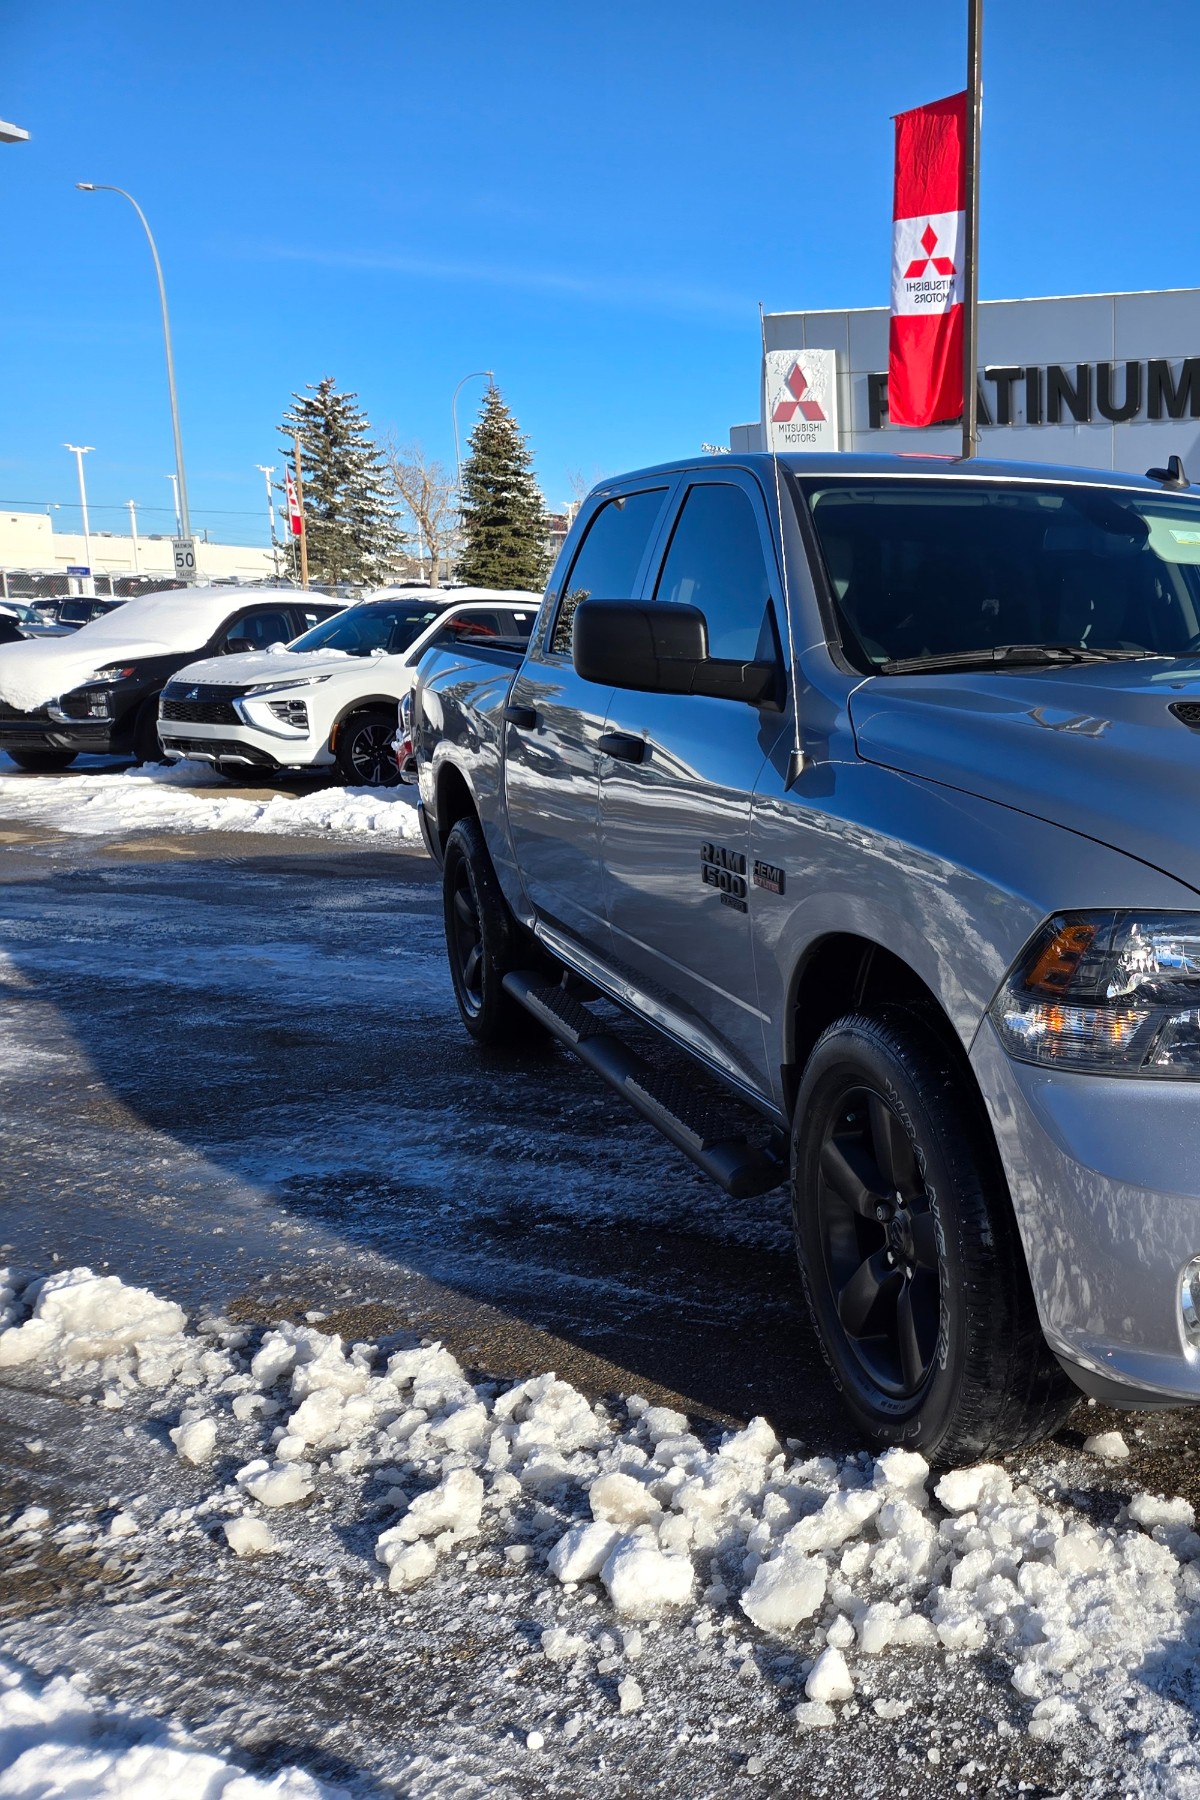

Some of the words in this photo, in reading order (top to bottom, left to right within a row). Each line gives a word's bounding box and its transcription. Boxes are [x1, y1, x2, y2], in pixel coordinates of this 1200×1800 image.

[778, 423, 822, 432] MITSUBISHI
[785, 433, 817, 443] MOTORS
[176, 552, 194, 567] 50
[700, 841, 746, 875] RAM
[701, 863, 748, 898] 1500
[753, 861, 781, 883] HEMI
